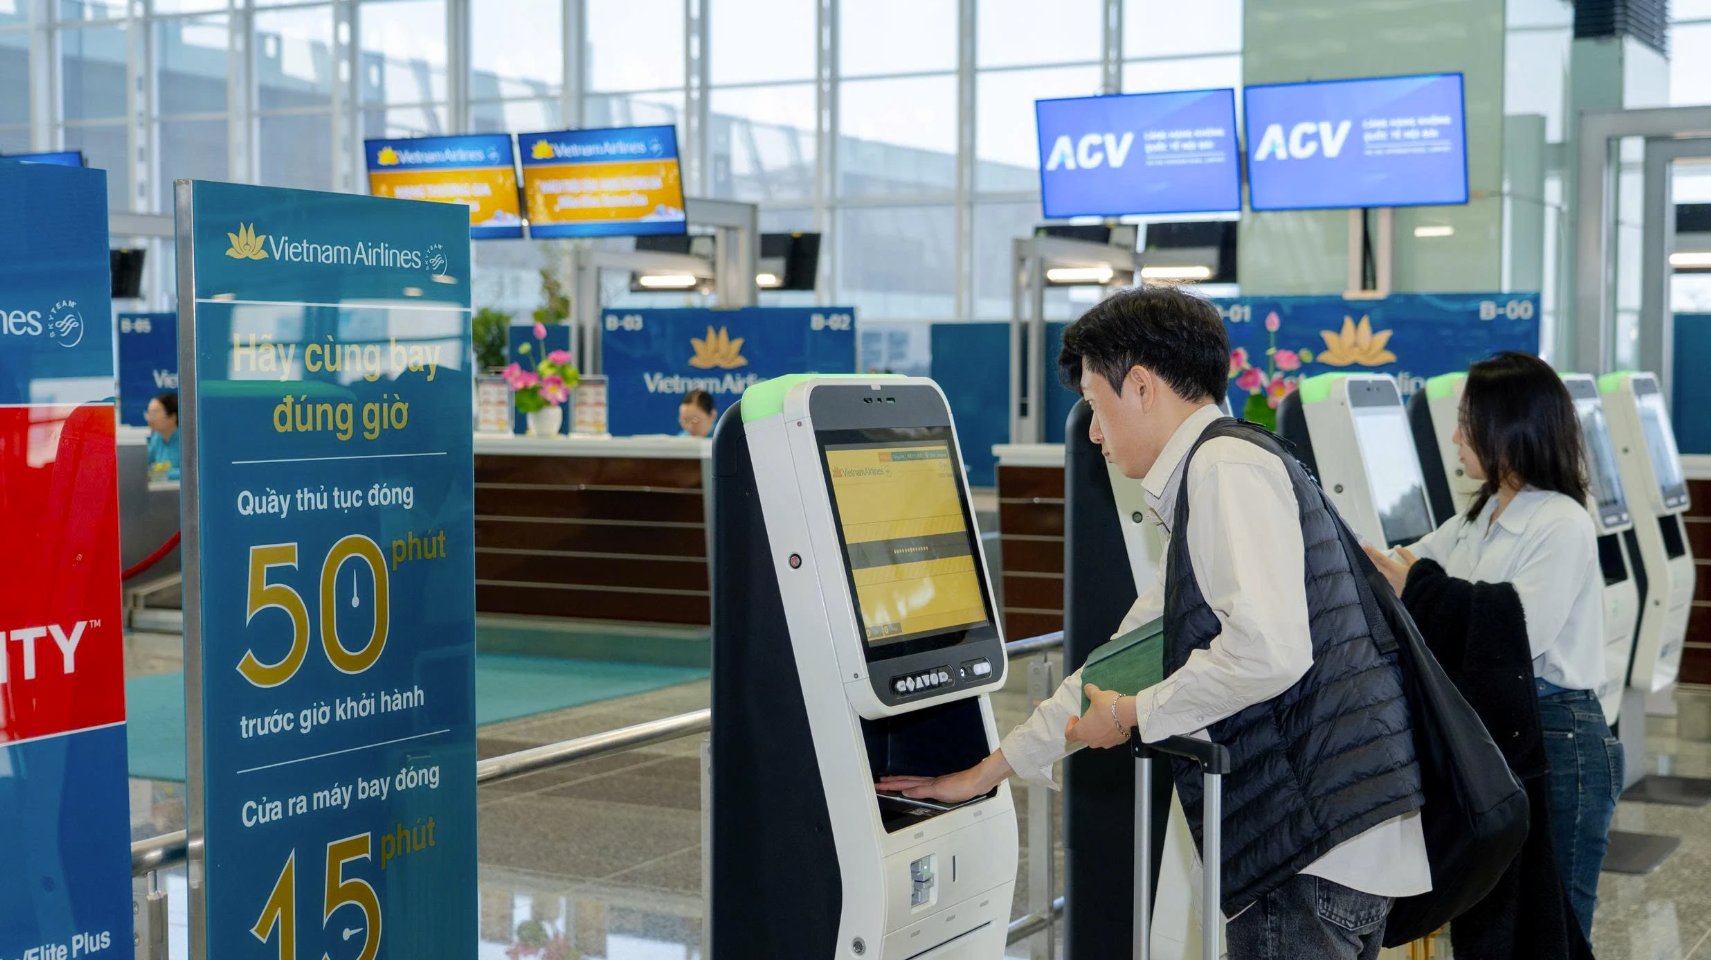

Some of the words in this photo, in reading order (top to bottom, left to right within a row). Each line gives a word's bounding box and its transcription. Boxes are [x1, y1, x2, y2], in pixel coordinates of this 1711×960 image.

[1046, 132, 1133, 171] ACV
[1254, 120, 1351, 161] ACV
[268, 235, 351, 264] Vietnam
[353, 241, 422, 269] Airlines
[48, 300, 77, 338] SKYTEAM
[810, 313, 850, 331] B-02
[1217, 304, 1250, 323] -01
[1479, 301, 1533, 320] B-00
[233, 333, 296, 382] Hãy
[305, 335, 381, 382] cùng
[390, 336, 441, 382] bay
[644, 372, 719, 394] Vietnam
[273, 395, 353, 441] đúng
[362, 394, 409, 440] giờ
[237, 487, 291, 519] Quầy
[296, 485, 328, 511] thủ
[333, 487, 363, 513] tục
[368, 483, 414, 509] đóng
[392, 529, 446, 571] phút
[235, 534, 389, 688] 50
[240, 709, 294, 739] trước
[300, 702, 330, 734] giờ
[335, 693, 375, 721] khởi
[380, 685, 425, 713] hành
[242, 797, 283, 828] Cửa
[288, 795, 307, 817] ra
[313, 783, 353, 809] máy
[358, 776, 391, 800] bay
[395, 765, 440, 791] đóng
[381, 816, 435, 870] phút
[249, 831, 382, 960] 15
[72, 930, 111, 958] Plus
